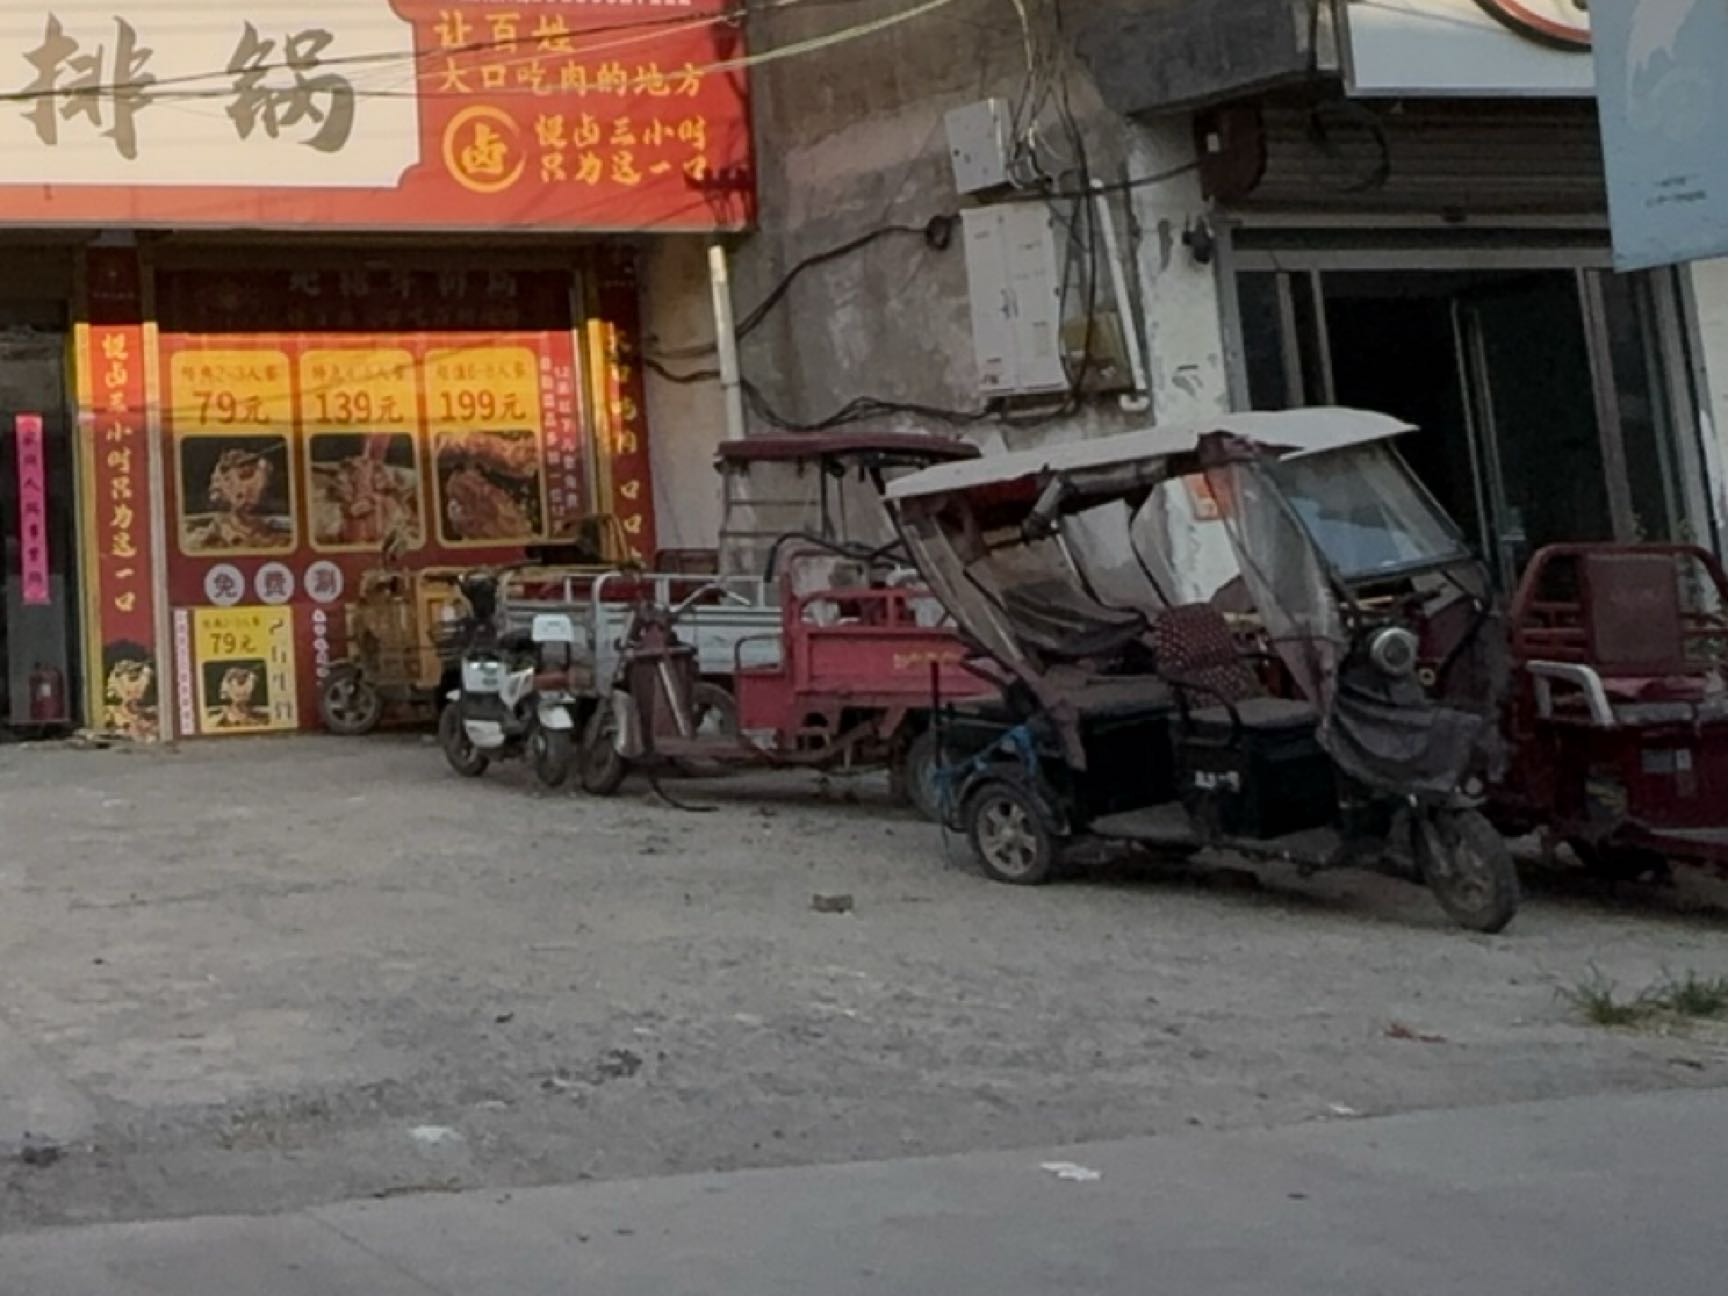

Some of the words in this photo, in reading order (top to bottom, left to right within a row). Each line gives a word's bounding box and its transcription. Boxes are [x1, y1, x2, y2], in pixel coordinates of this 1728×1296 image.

[433, 8, 577, 53] 让百姓
[438, 56, 706, 96] 大口吃肉的地方
[192, 390, 270, 425] 79元
[315, 389, 404, 424] 139元
[440, 388, 527, 423] 199元
